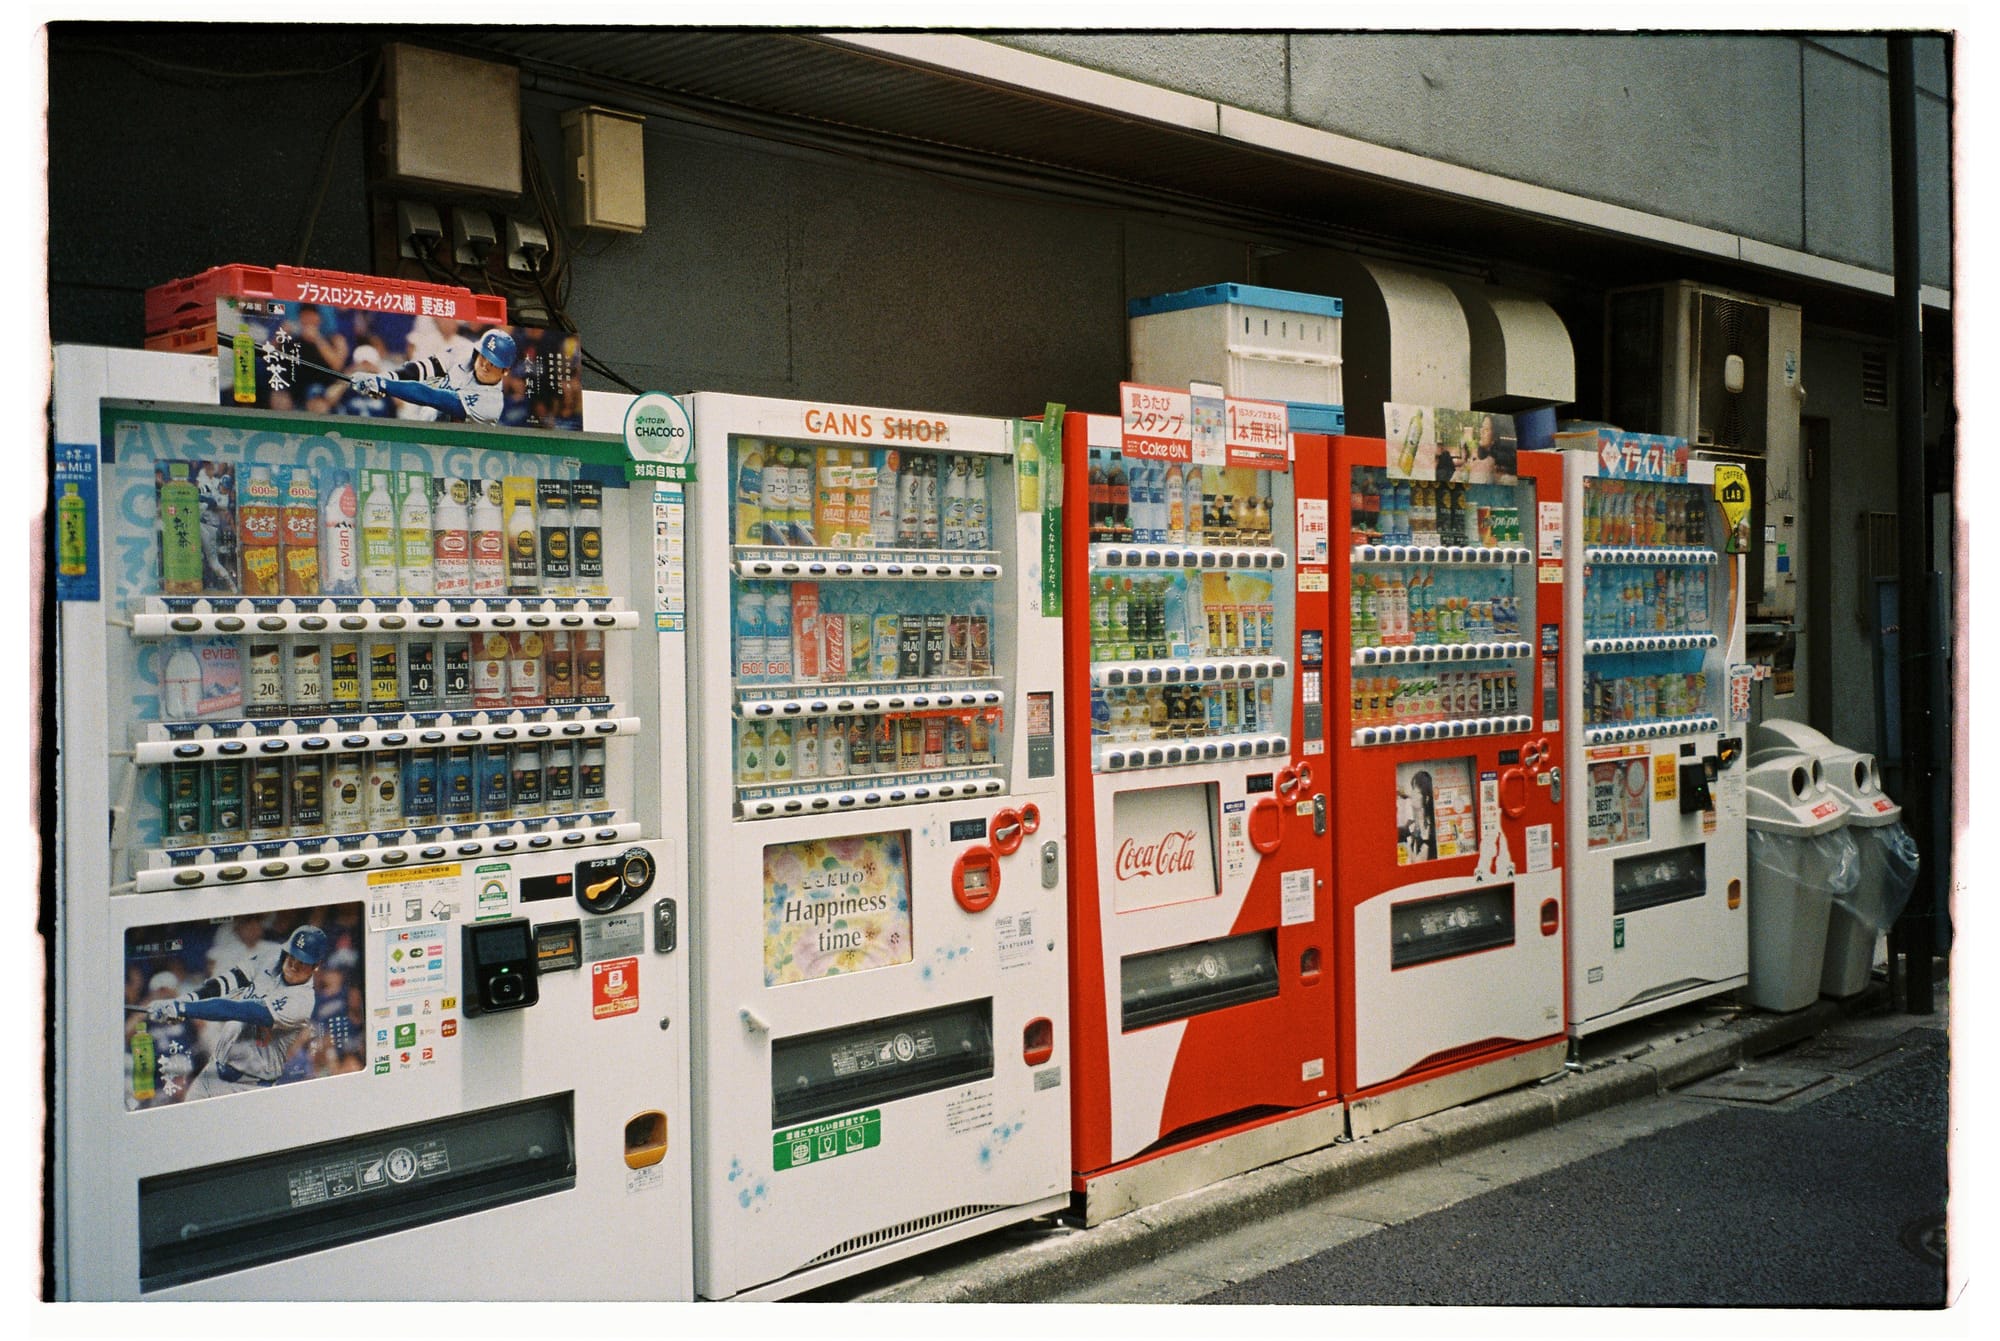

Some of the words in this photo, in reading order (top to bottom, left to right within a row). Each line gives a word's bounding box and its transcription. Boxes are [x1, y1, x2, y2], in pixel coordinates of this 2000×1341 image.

[421, 296, 456, 317] 要返却
[1131, 393, 1170, 411] 買うたび
[1131, 411, 1185, 434] スタンプ
[635, 426, 684, 437] CHACOCO
[883, 417, 948, 443] SHOP
[1140, 440, 1168, 457] Coke
[68, 462, 92, 473] MLB
[634, 464, 687, 479] 対応自販機
[1723, 470, 1744, 481] COFFEE
[1726, 489, 1742, 500] LAB
[245, 516, 277, 531] むぎ茶
[287, 516, 317, 532] むぎ茶
[339, 530, 351, 567] evian
[903, 641, 920, 652] BLAC
[927, 640, 944, 651] BLAC
[260, 682, 275, 696] 20
[303, 682, 317, 695] 20
[340, 681, 354, 693] 90
[378, 681, 393, 692] 90
[419, 678, 428, 691] 0
[455, 677, 464, 690] 0
[1596, 799, 1612, 811] BEST
[1115, 830, 1197, 881] Coca-Cola
[802, 871, 864, 890] ここだけの
[785, 893, 887, 926] Happiness
[819, 928, 861, 952] time
[375, 1055, 390, 1063] LINE
[376, 1065, 389, 1074] Pay
